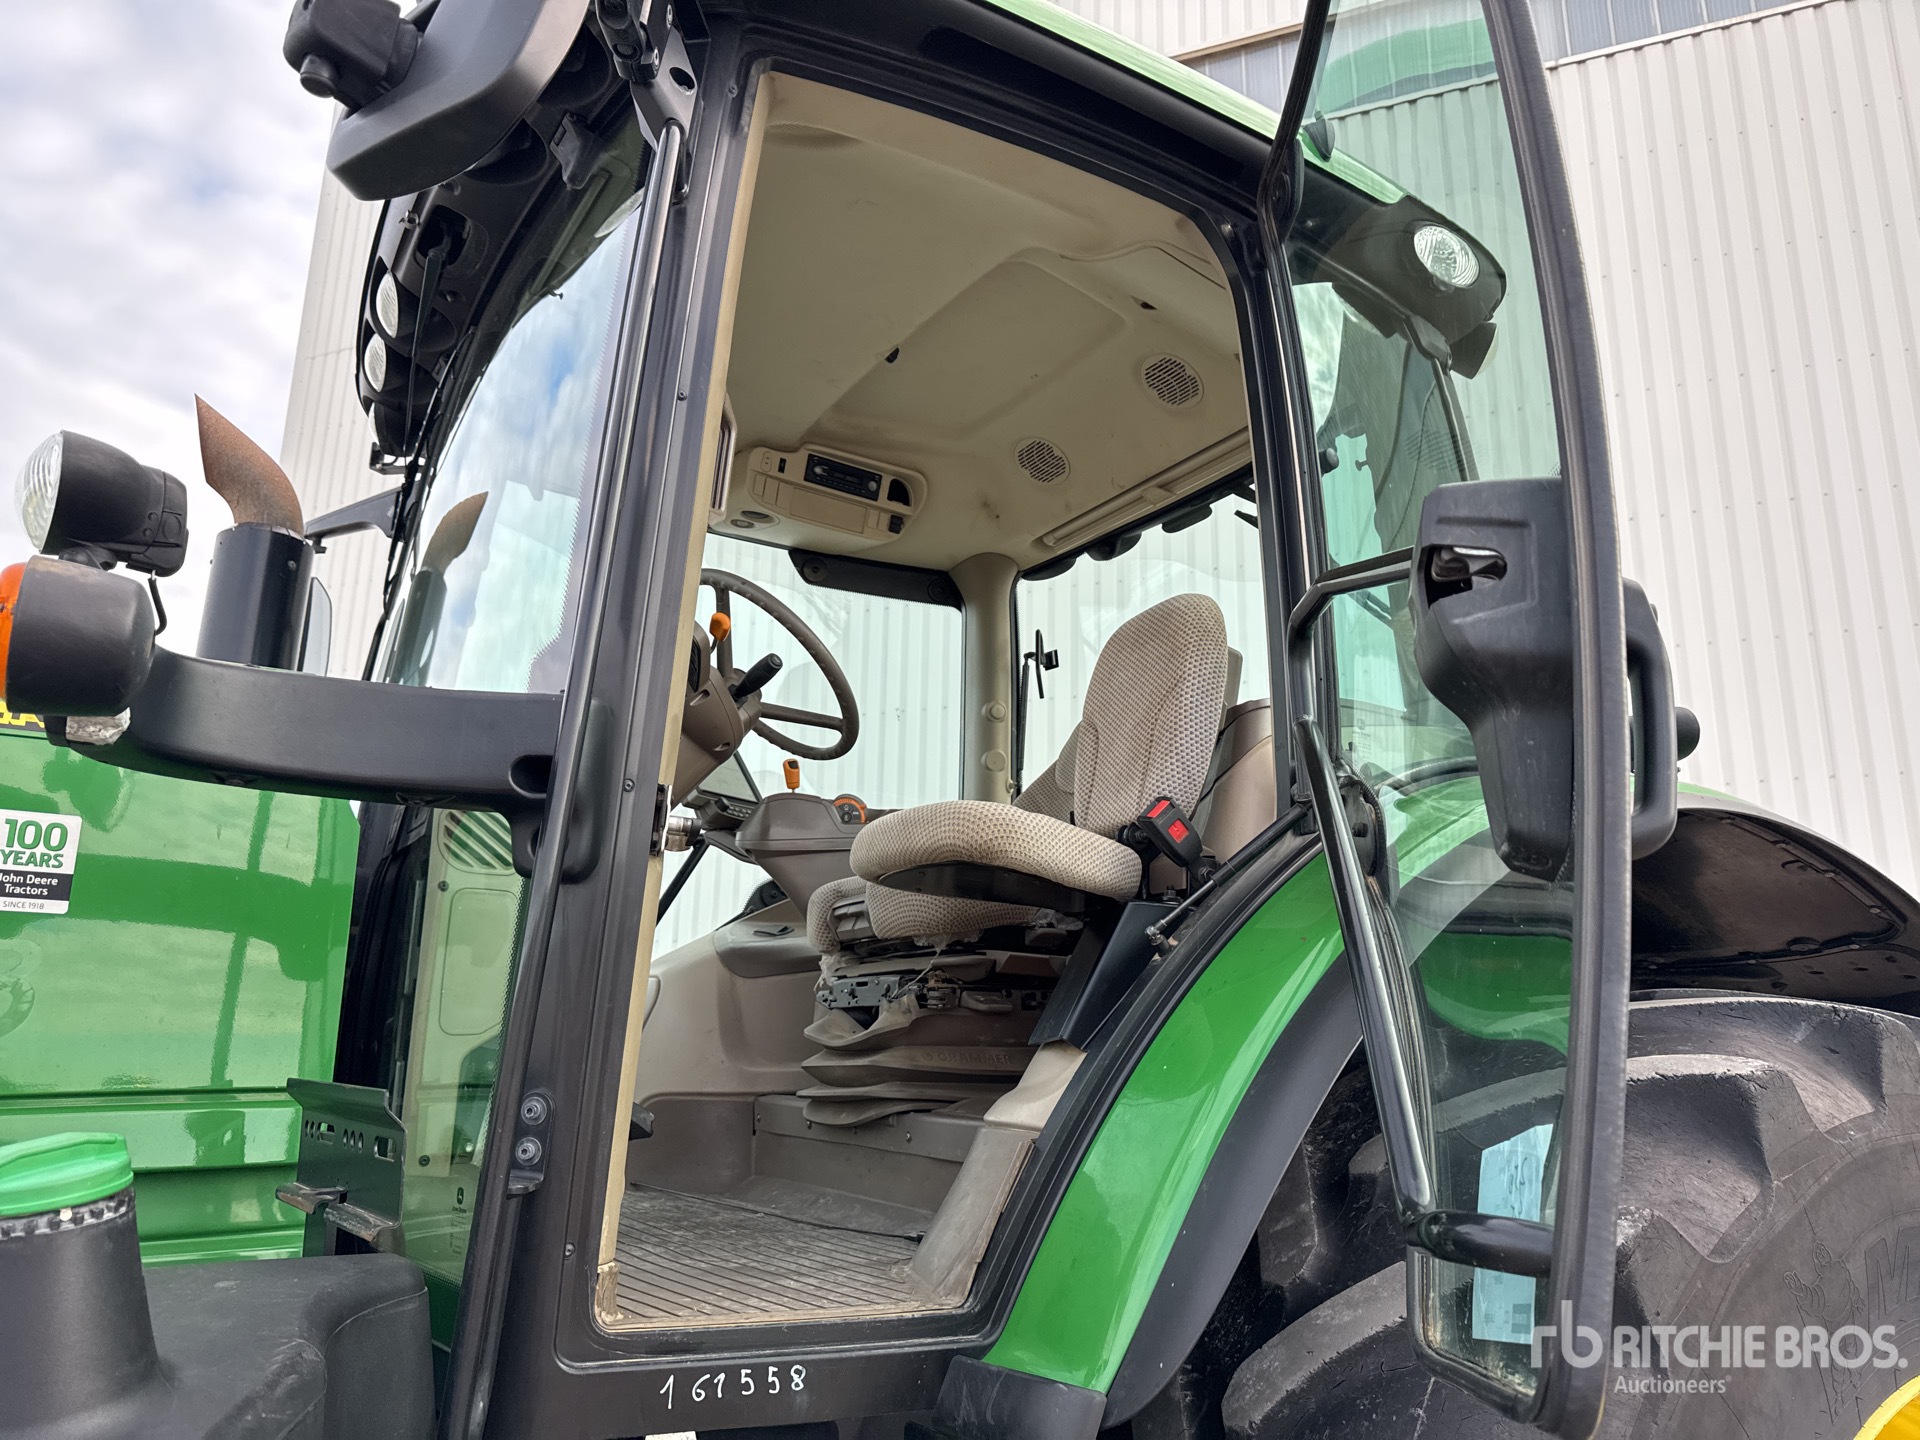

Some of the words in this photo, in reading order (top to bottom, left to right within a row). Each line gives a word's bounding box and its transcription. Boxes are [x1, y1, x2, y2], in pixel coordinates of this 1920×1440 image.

[5, 818, 68, 852] 100
[0, 849, 64, 868] YEARS
[26, 874, 58, 886] Deere
[4, 884, 49, 896] Tractors
[3, 901, 26, 909] SINCE
[28, 902, 45, 910] 1918
